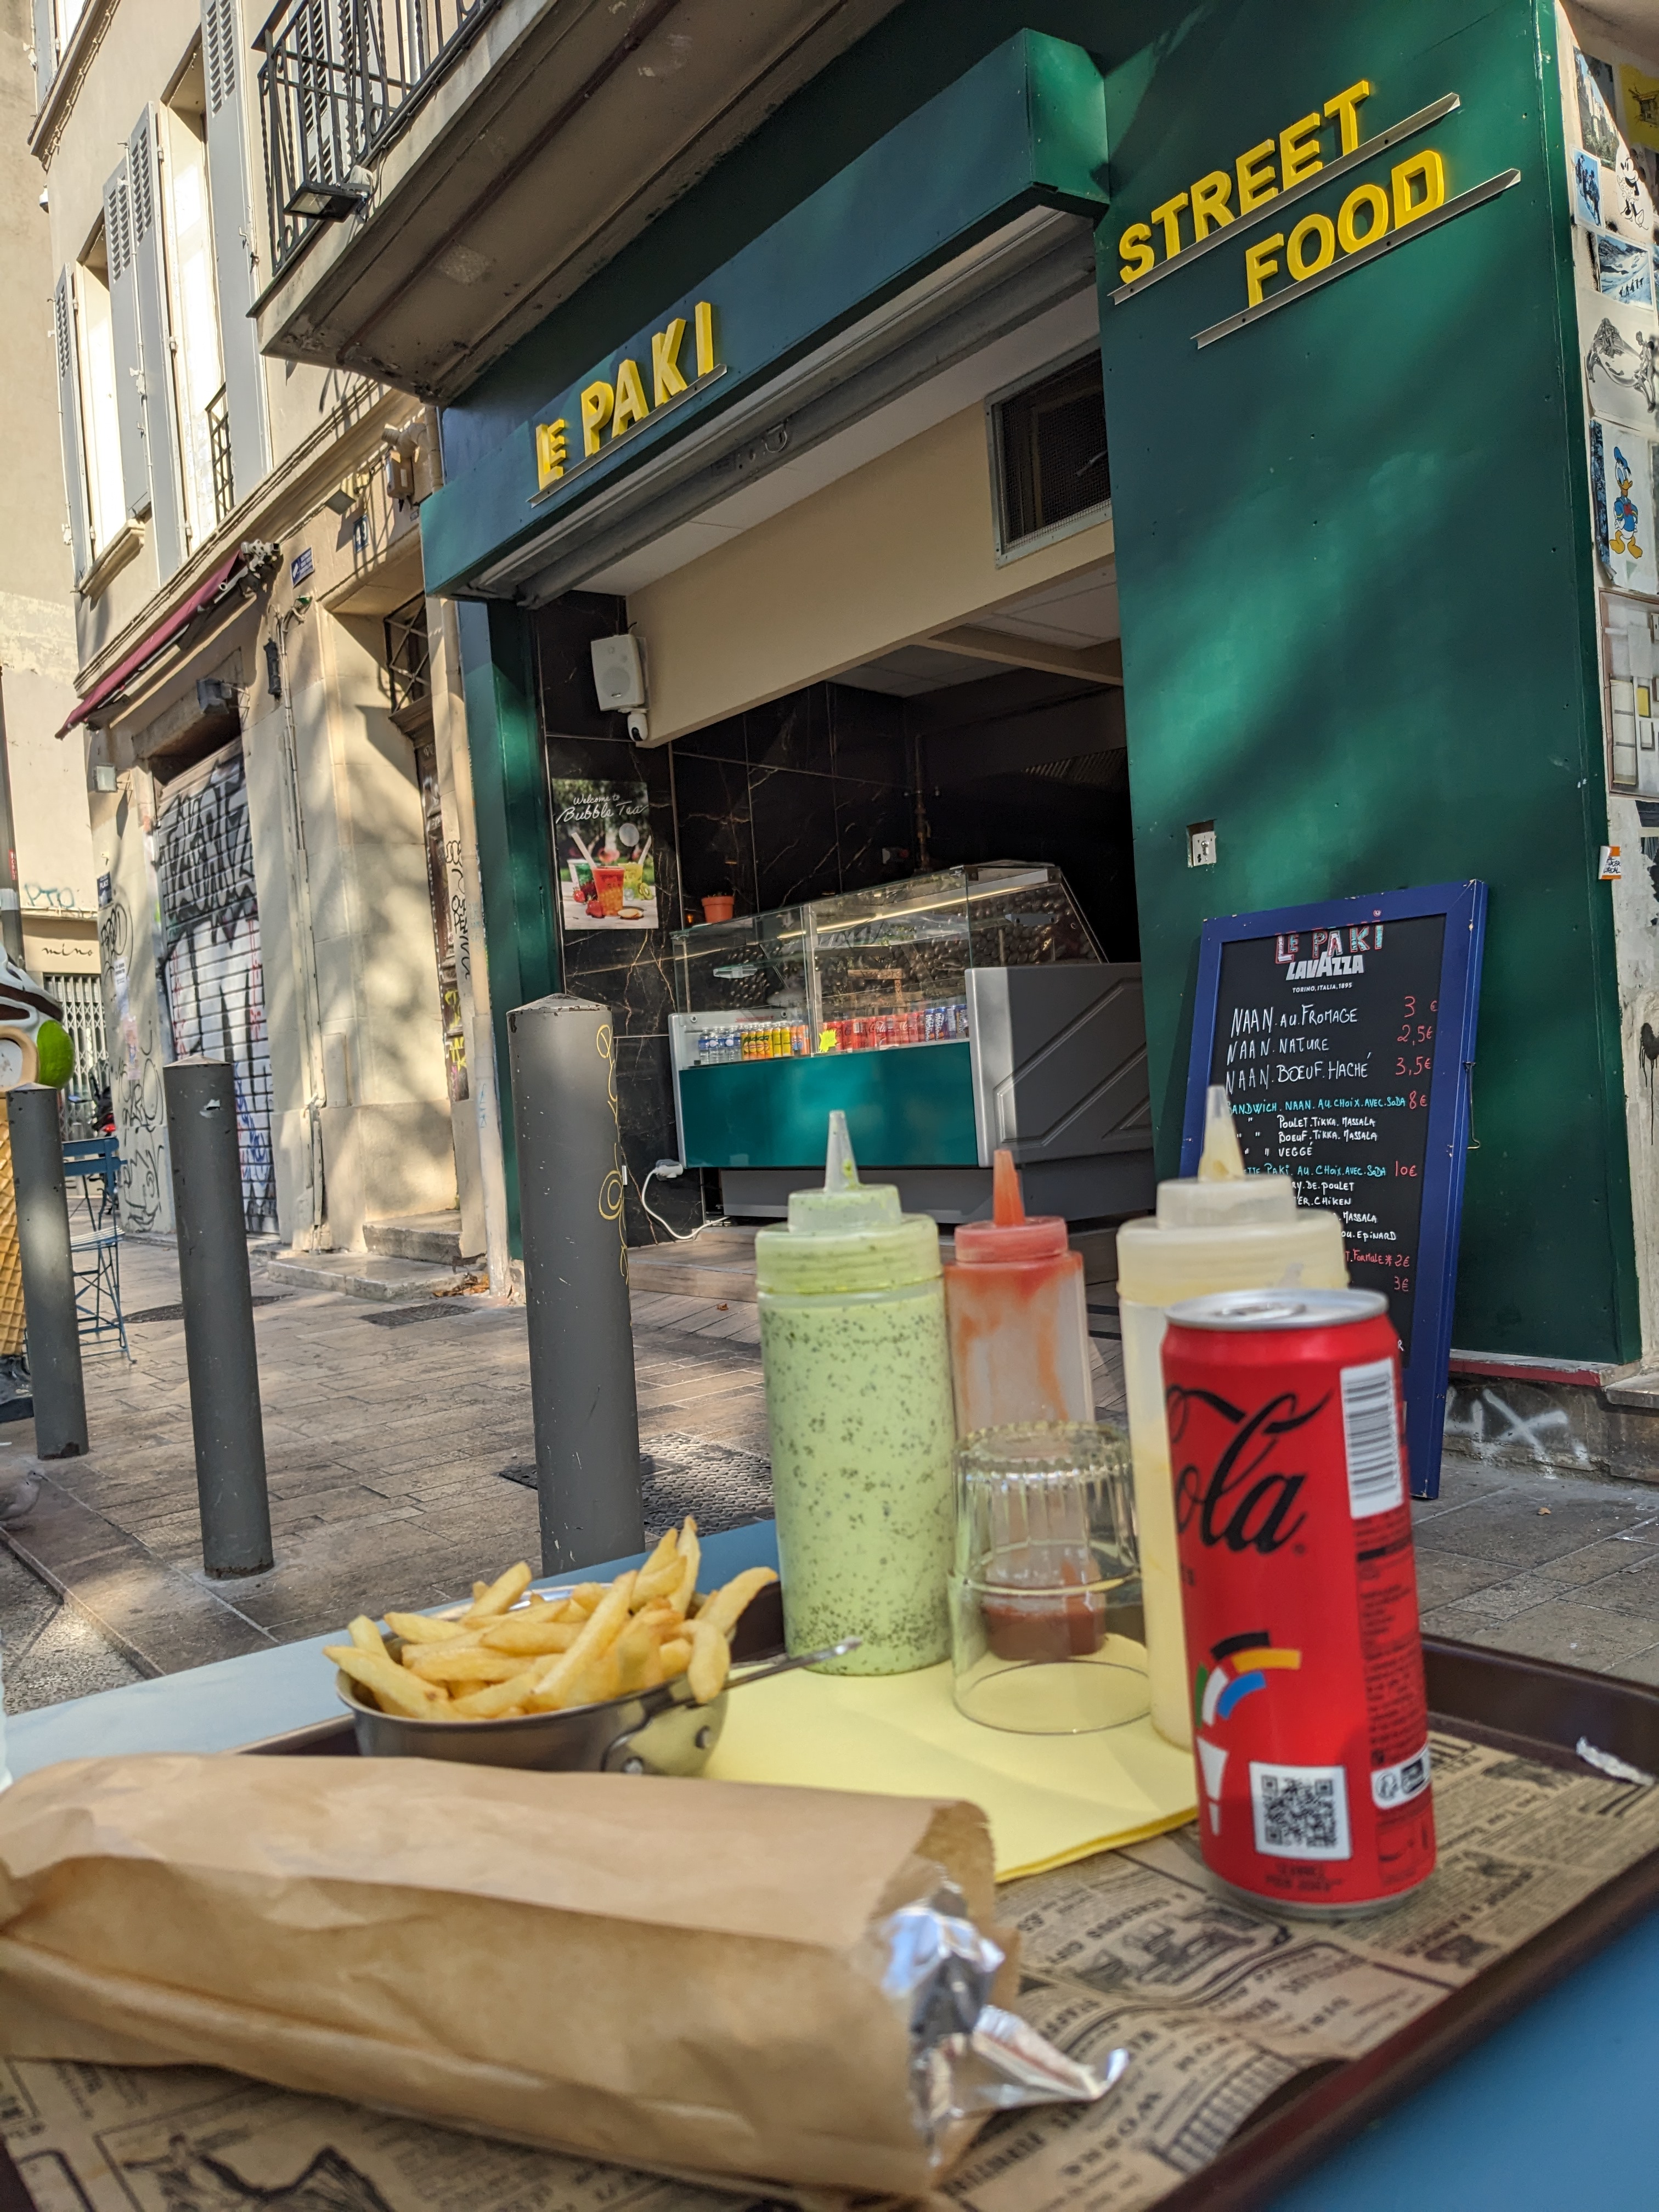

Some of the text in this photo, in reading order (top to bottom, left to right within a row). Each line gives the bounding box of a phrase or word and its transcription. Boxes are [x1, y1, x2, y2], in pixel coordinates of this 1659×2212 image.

[1120, 80, 1370, 284] STREET
[1245, 150, 1445, 307] FOOD
[535, 301, 714, 490] LE PAKI
[573, 794, 611, 805] Welcome
[556, 800, 649, 824] Bubble Tea
[1275, 931, 1300, 964] LE
[1285, 951, 1364, 980] LAVAZZA
[1404, 996, 1416, 1018] 3
[1279, 1037, 1330, 1054] NATURE
[1342, 1116, 1376, 1127] MASSALA
[1344, 1129, 1378, 1142] MASSALA
[1343, 1211, 1378, 1224] MASSALA
